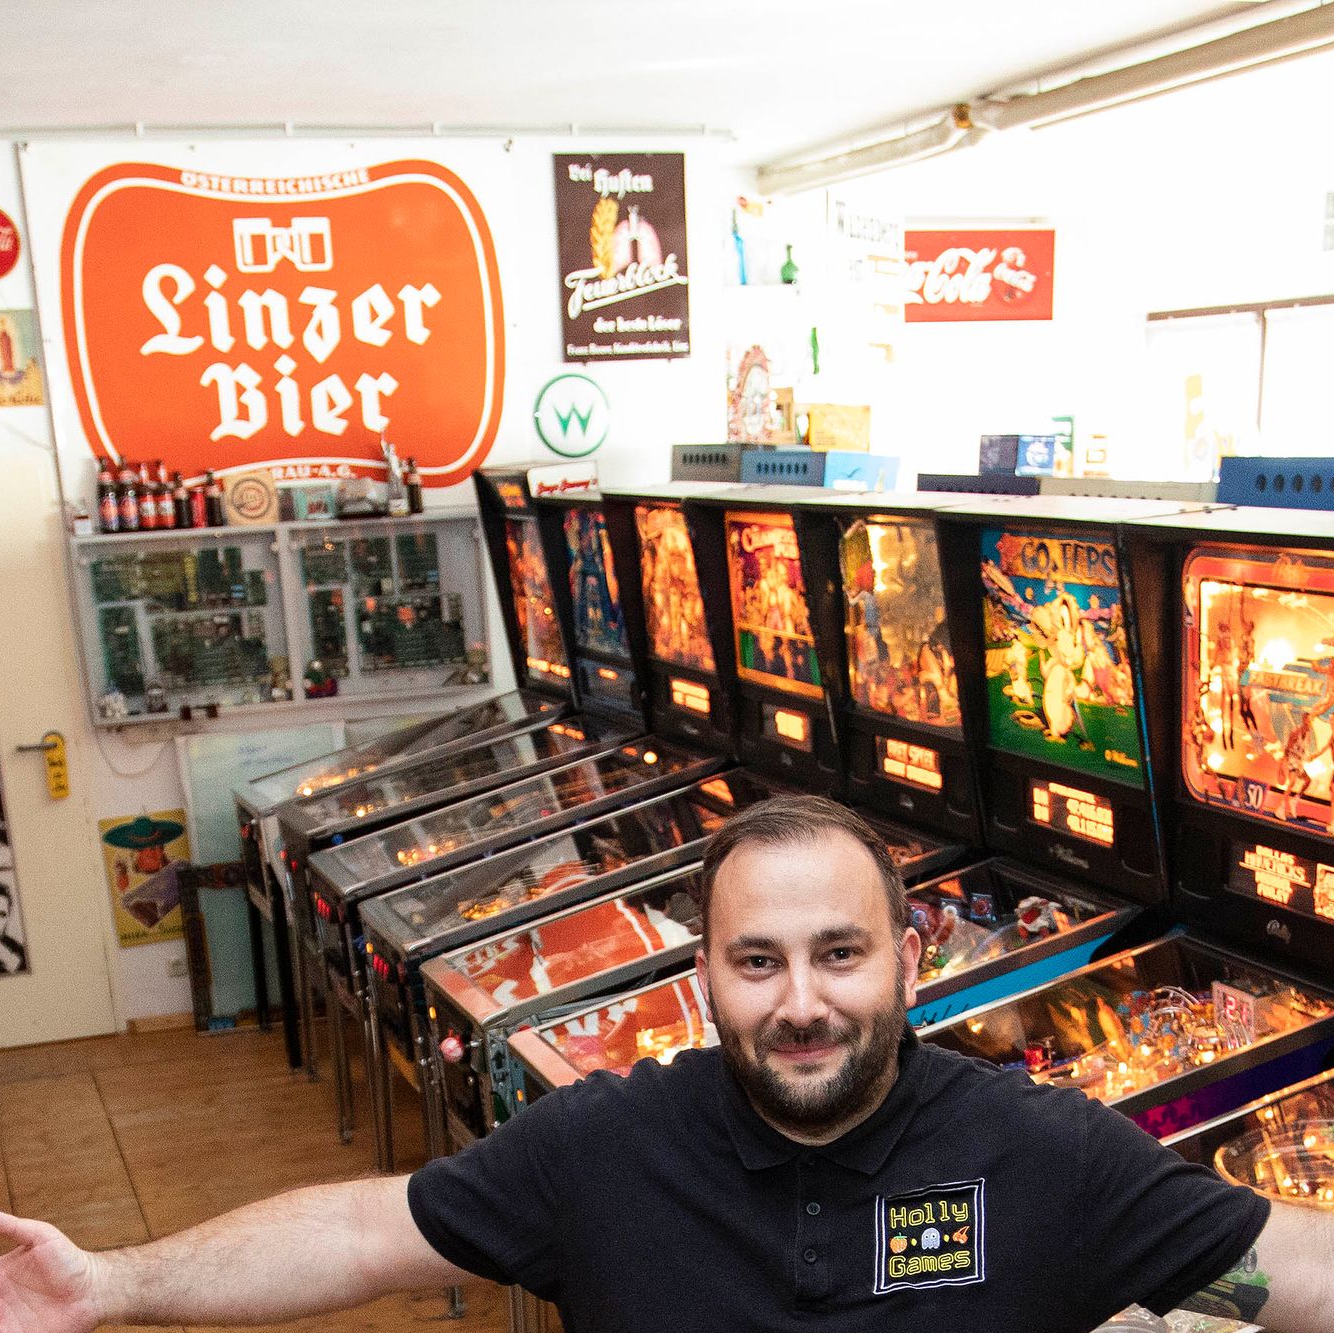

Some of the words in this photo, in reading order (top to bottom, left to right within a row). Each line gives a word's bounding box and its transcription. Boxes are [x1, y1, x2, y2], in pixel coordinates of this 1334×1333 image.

[140, 263, 441, 362] Linzer
[200, 354, 399, 442] Bier
[890, 1201, 969, 1229] Holly
[889, 1250, 971, 1278] Games
